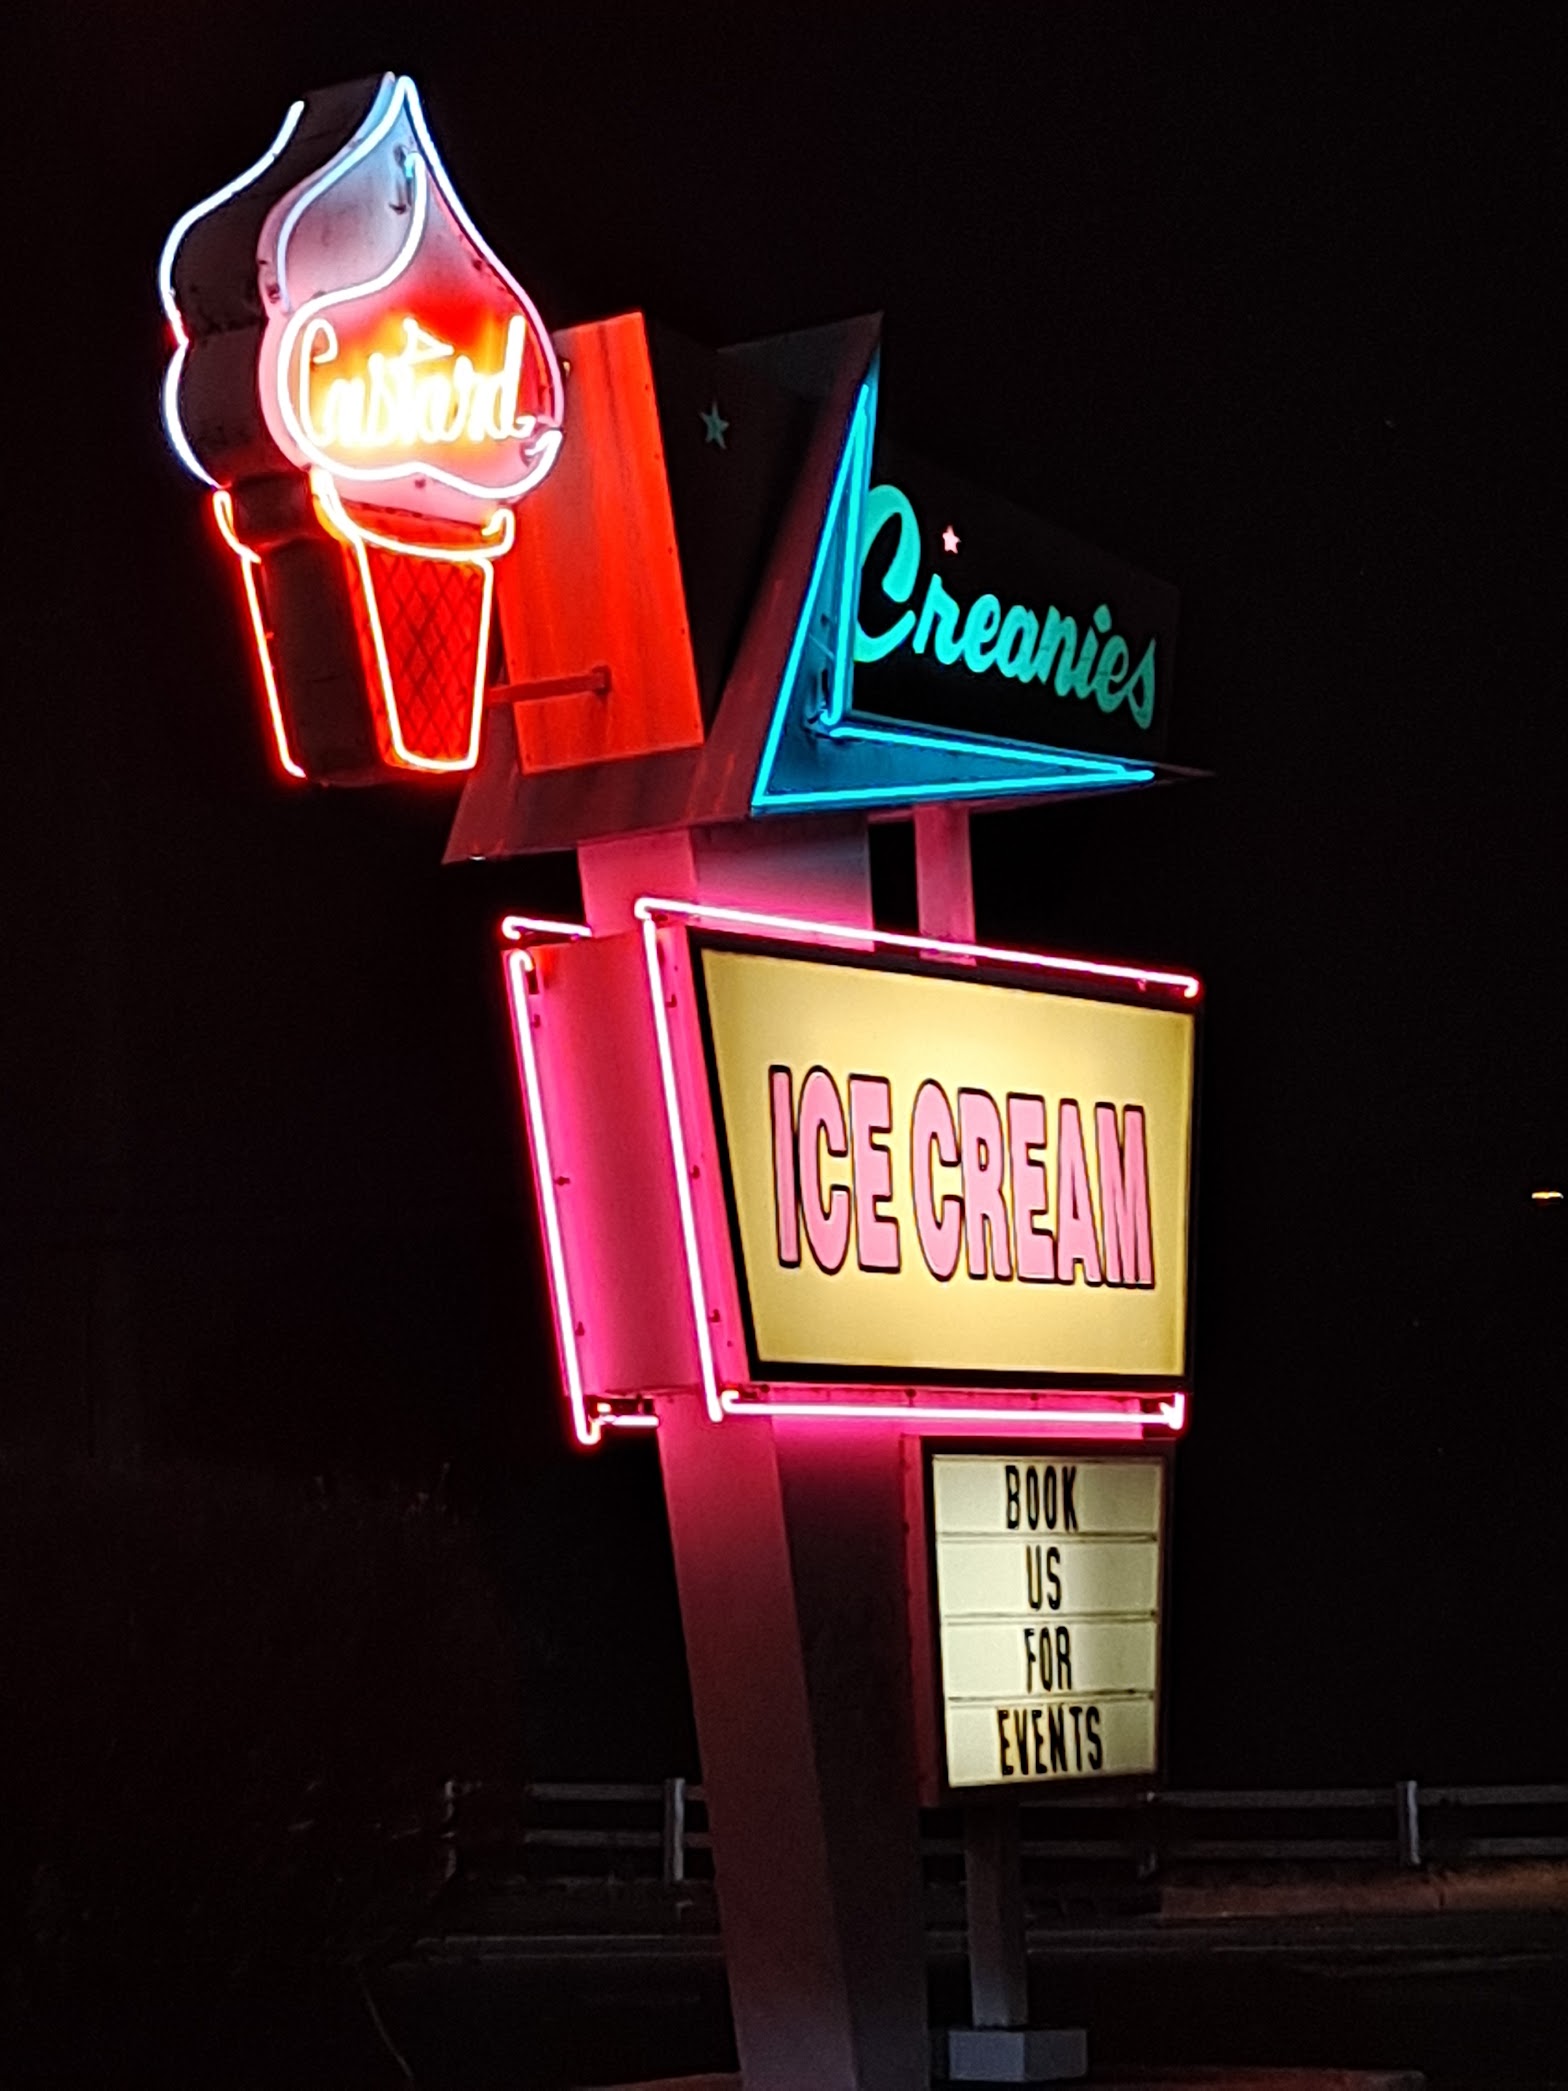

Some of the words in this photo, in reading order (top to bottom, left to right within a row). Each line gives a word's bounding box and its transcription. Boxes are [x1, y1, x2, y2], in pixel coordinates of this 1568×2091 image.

[301, 318, 536, 447] Custard
[769, 1064, 900, 1276] ICE
[909, 1078, 1155, 1289] CREAM
[1005, 1465, 1078, 1531] BOOK
[1026, 1545, 1061, 1611] US
[1024, 1626, 1072, 1693] FOR
[998, 1703, 1103, 1776] EVENTS
